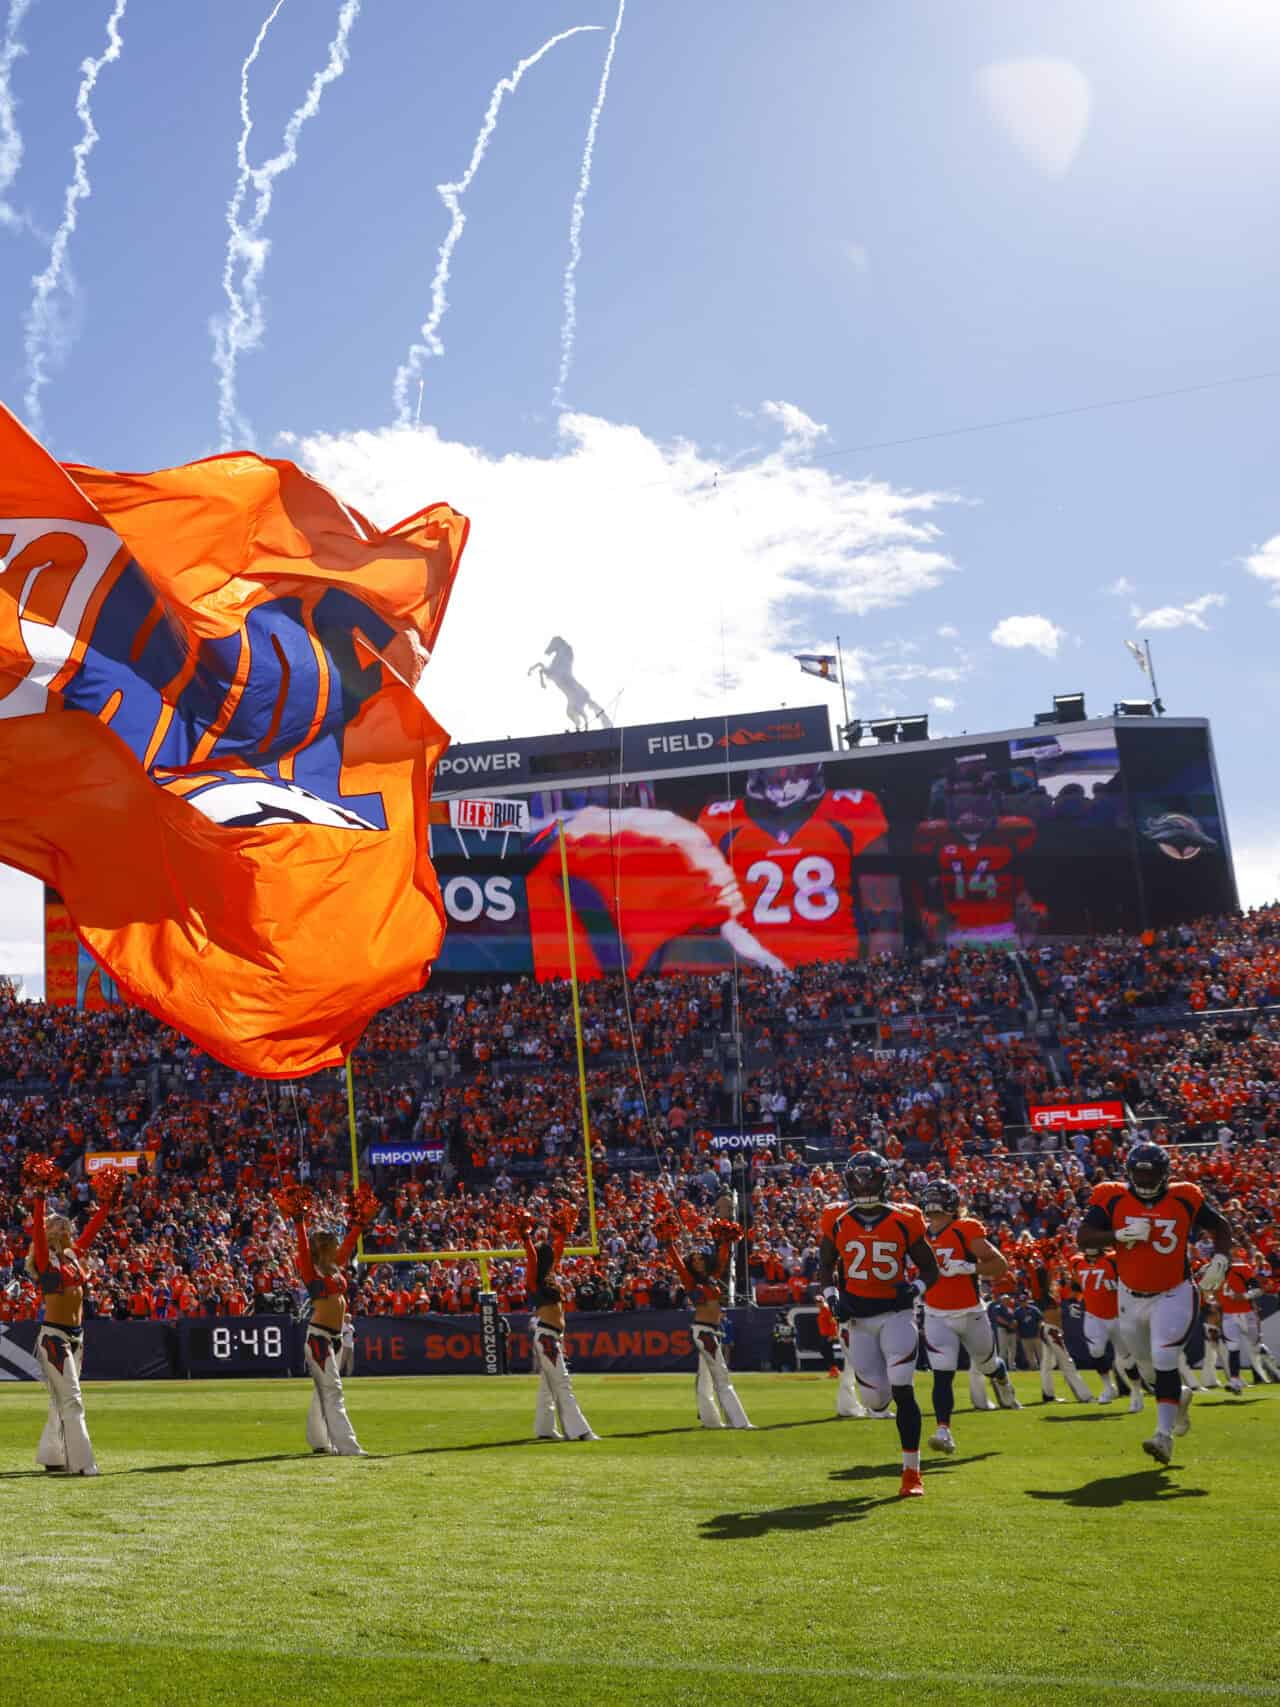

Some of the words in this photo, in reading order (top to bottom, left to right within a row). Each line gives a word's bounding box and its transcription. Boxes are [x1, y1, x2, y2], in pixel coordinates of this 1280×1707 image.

[435, 752, 521, 776] POWER
[648, 732, 715, 755] FIELD
[459, 801, 493, 826] LET'S
[746, 855, 840, 924] 28
[951, 860, 998, 898] 14
[710, 1133, 777, 1149] MPOWER
[844, 1240, 899, 1281] 25
[1079, 1268, 1105, 1291] 77
[212, 1327, 282, 1358] 8:48
[362, 1335, 408, 1361] HE
[482, 1305, 497, 1374] BRONCOS
